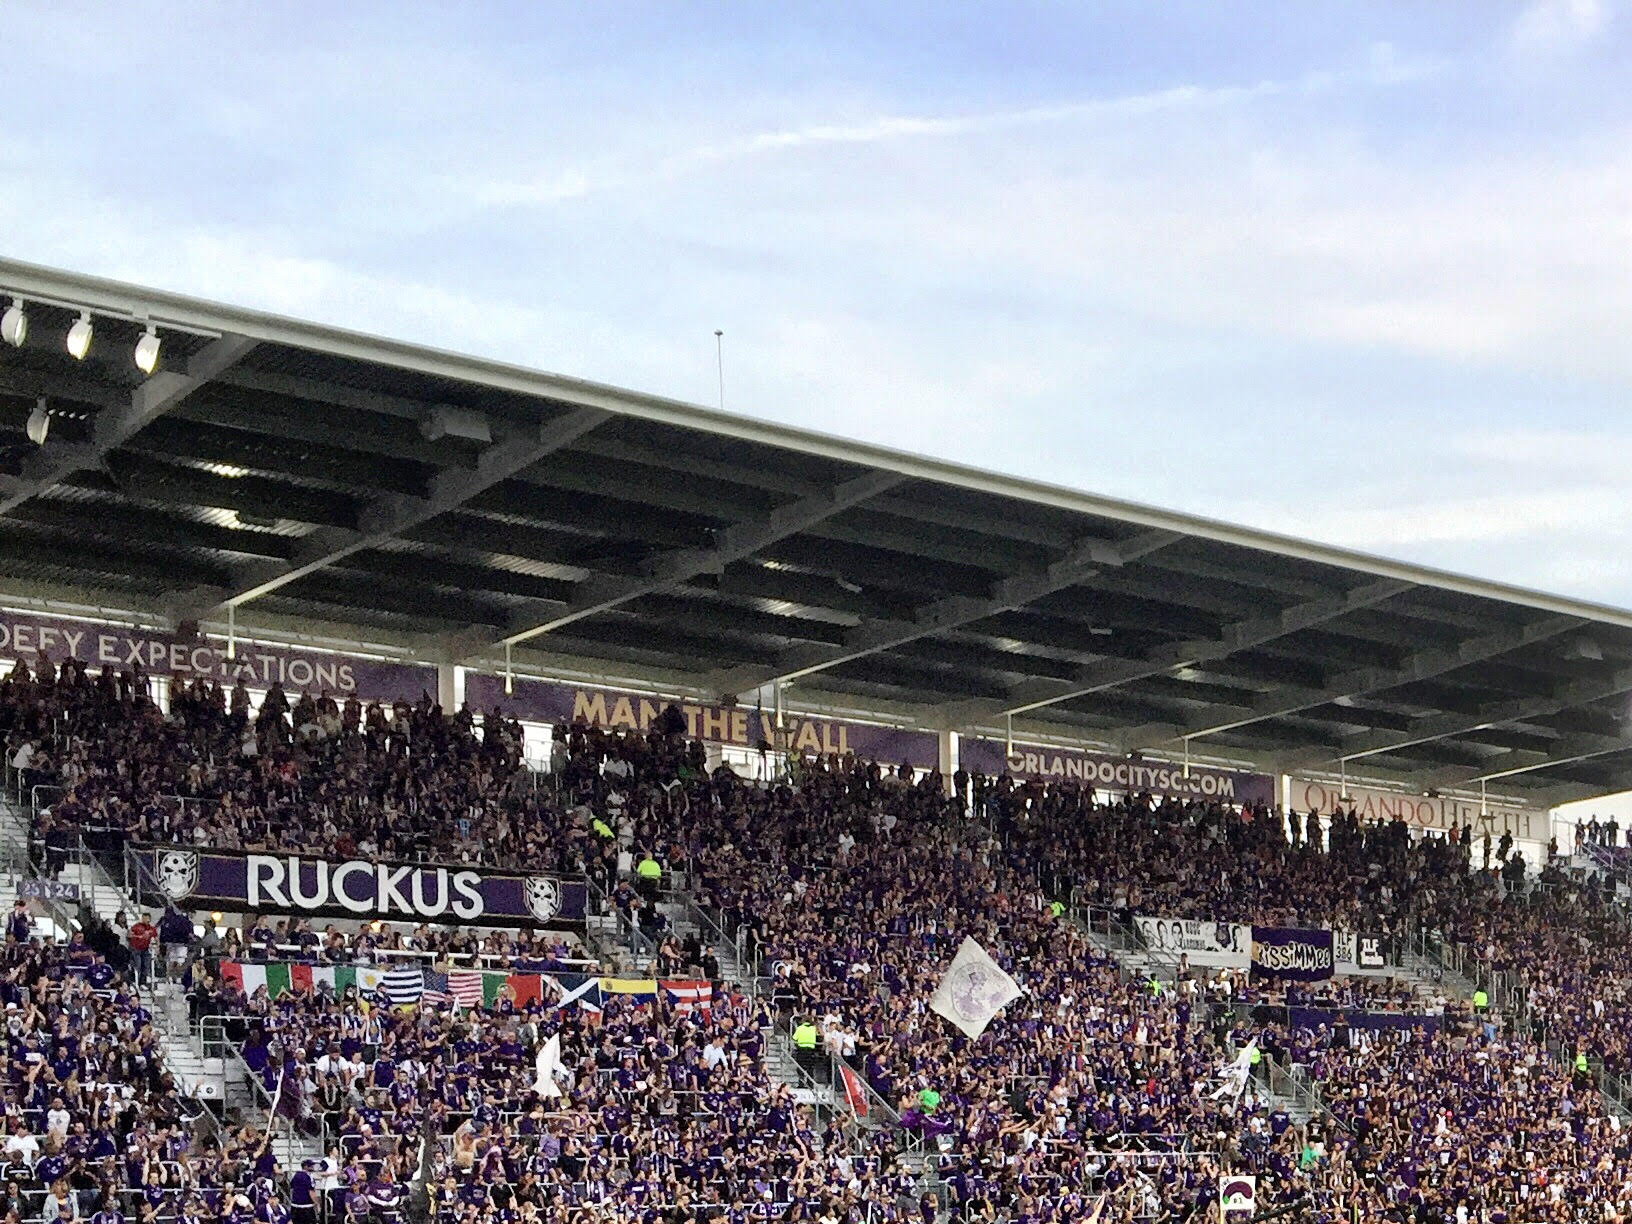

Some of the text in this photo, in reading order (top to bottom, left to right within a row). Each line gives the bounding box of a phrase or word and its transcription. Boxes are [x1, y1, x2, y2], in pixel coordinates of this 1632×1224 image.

[98, 635, 357, 691] EXPECTATIONS
[682, 704, 749, 743] THE
[760, 713, 855, 756] WALL
[1007, 751, 1235, 798] ORLANDOCITYSC.COM
[246, 854, 485, 920] RUCKUS
